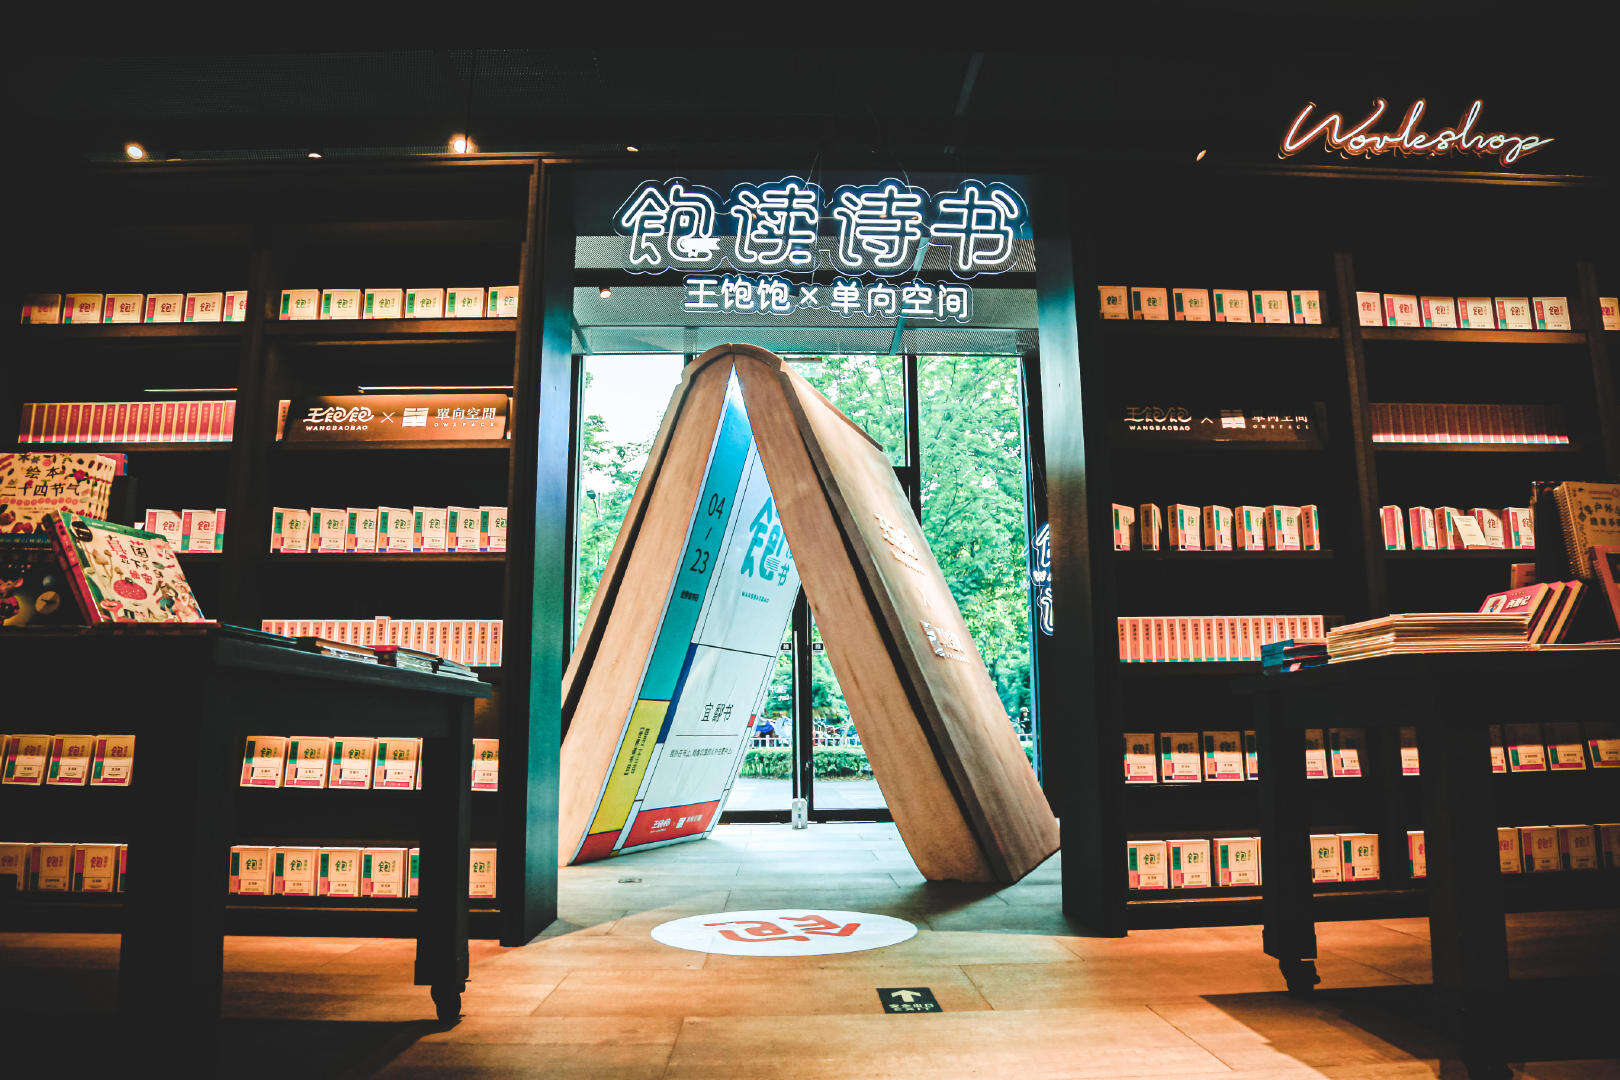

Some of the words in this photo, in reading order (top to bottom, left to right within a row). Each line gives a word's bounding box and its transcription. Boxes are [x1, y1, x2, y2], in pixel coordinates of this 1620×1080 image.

[686, 278, 790, 310] 王饱饱
[832, 283, 969, 318] 单向空间
[435, 407, 497, 420] 單向空間
[25, 466, 61, 479] 绘本
[1, 482, 80, 497] 二十四节气
[708, 493, 726, 519] 04
[689, 548, 709, 574] 23
